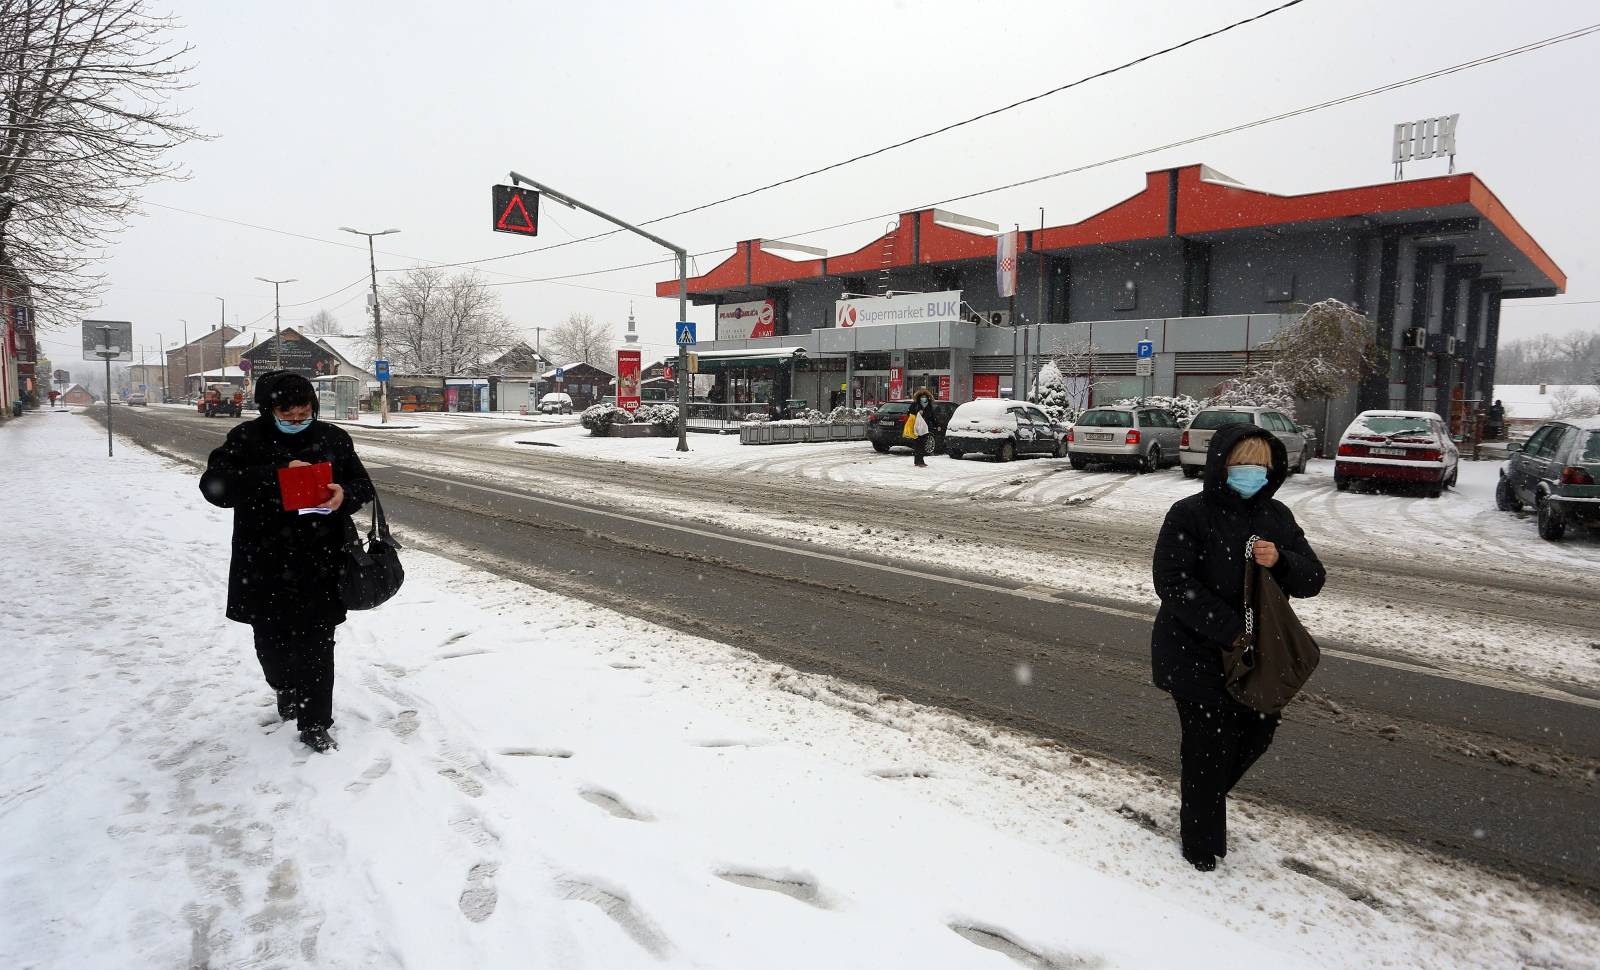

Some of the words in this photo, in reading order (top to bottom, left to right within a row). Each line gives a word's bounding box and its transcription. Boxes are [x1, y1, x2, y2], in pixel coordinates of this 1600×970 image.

[1392, 113, 1460, 163] BUK
[859, 306, 923, 321] Supermarket
[927, 301, 956, 317] BUK
[1141, 345, 1149, 356] P
